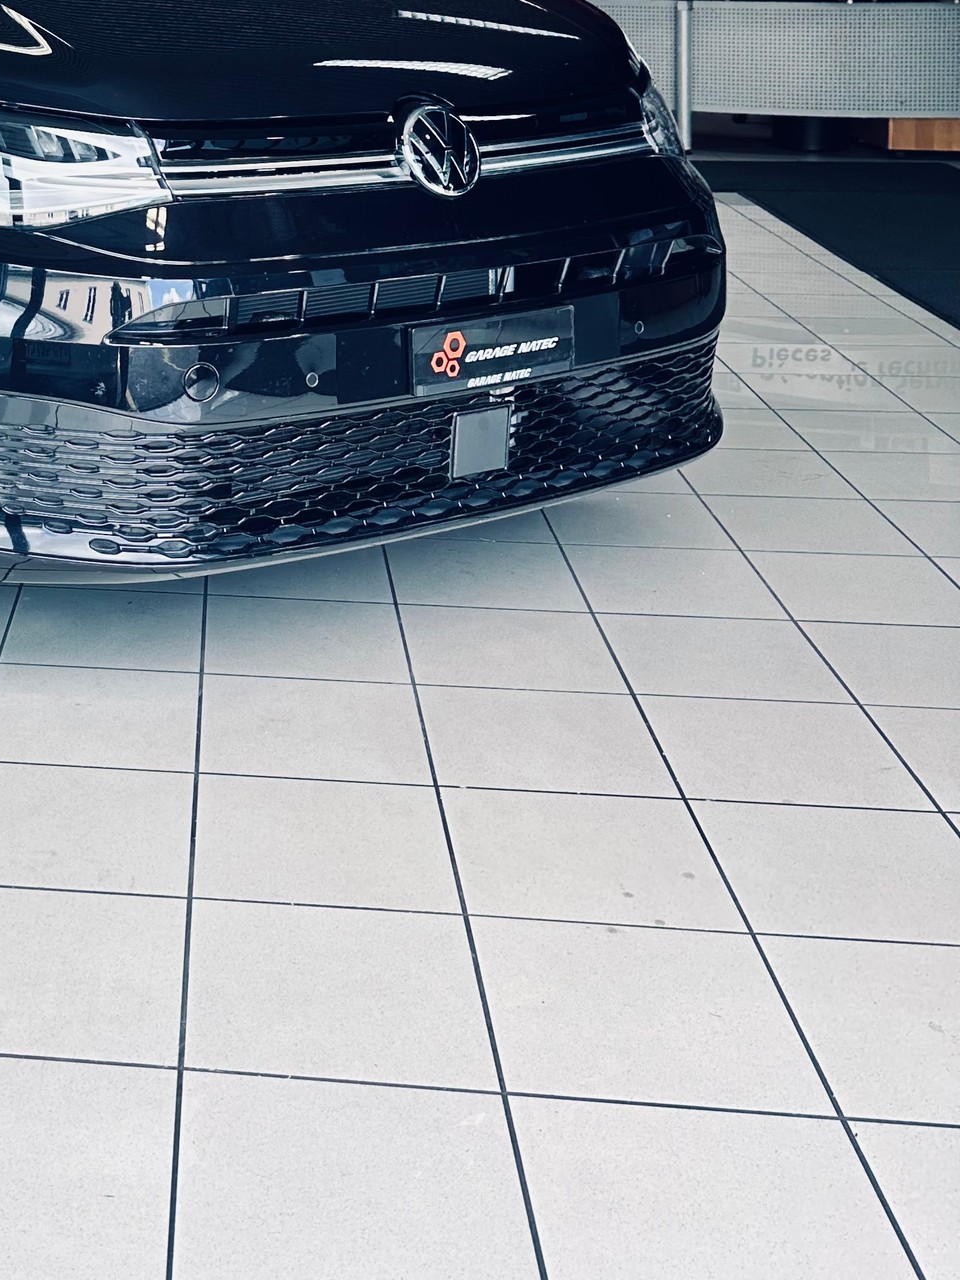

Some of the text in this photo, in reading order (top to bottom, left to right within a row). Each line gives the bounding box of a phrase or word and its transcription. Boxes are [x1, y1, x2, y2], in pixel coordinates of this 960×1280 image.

[465, 336, 559, 362] GARAGE NATEC
[467, 367, 532, 388] GARAGE NATEC
